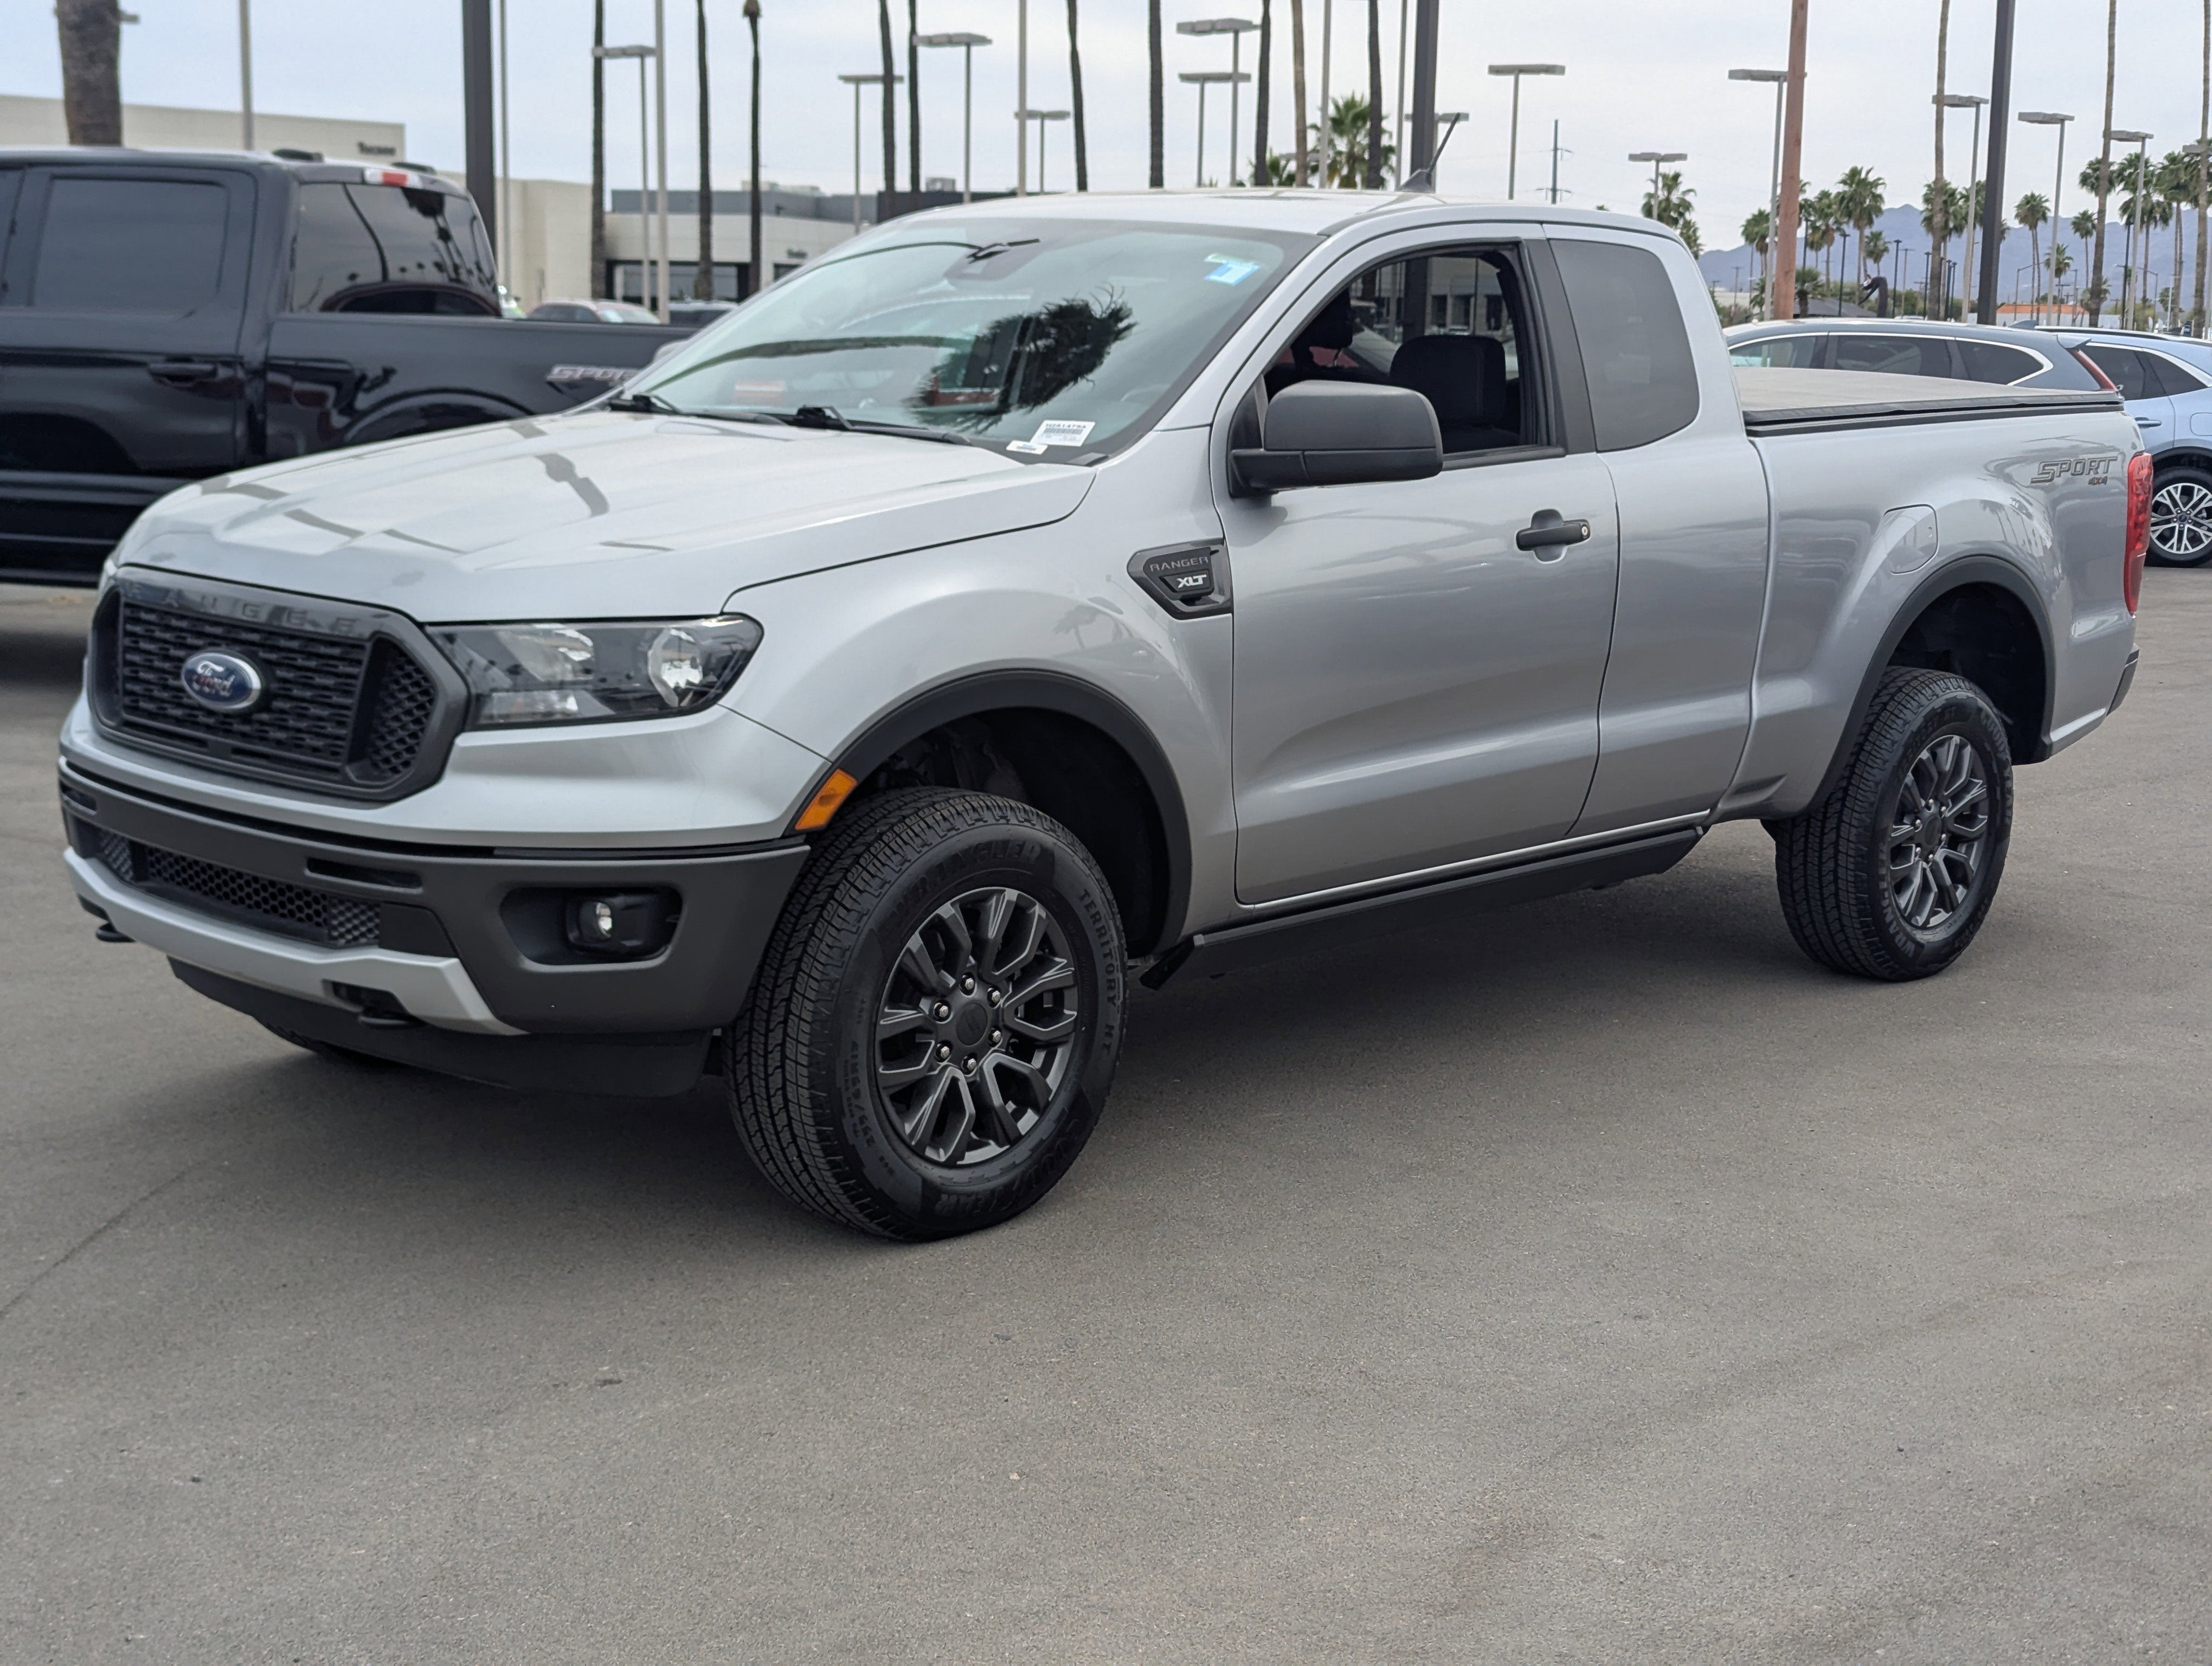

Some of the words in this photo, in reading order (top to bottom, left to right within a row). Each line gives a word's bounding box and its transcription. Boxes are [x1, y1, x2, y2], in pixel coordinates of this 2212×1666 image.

[2030, 456, 2118, 484] SPORT
[1149, 556, 1208, 572] RANGER
[1176, 574, 1207, 588] XLT
[192, 660, 235, 697] Ford
[1079, 888, 1117, 1008] TERRITORY
[1101, 1024, 1115, 1055] HT
